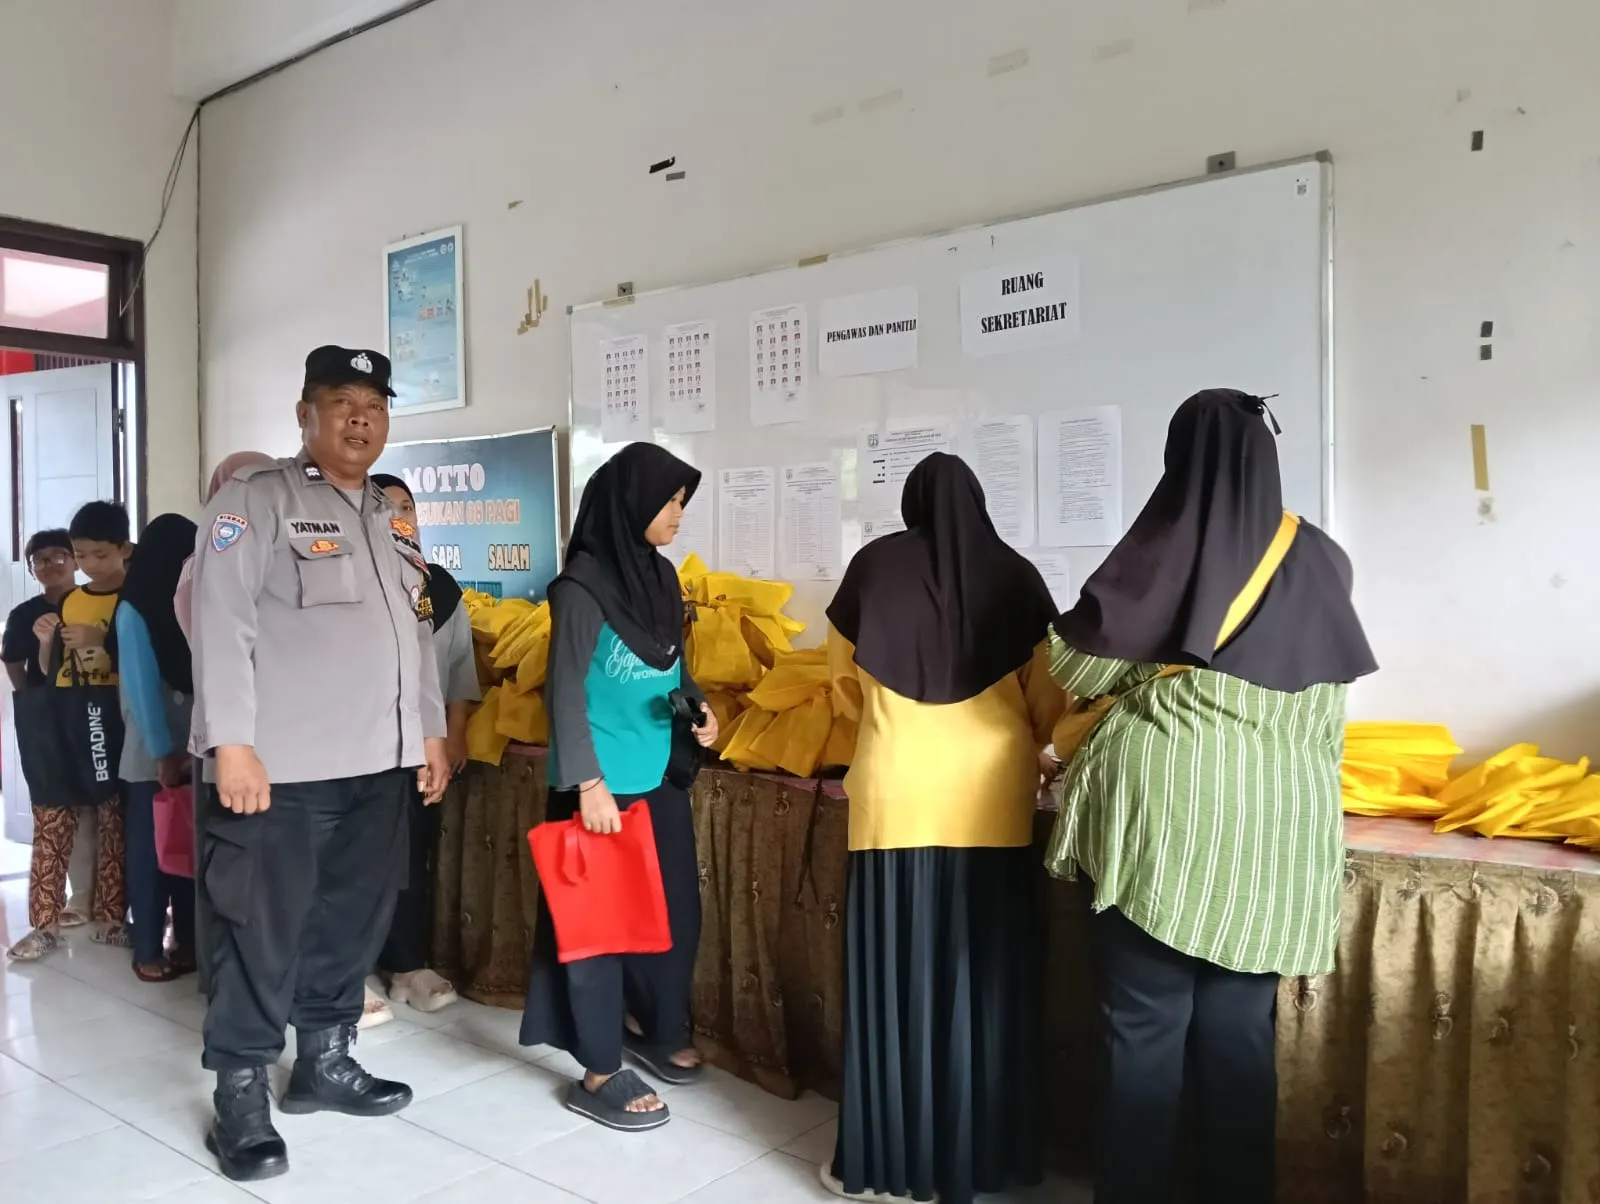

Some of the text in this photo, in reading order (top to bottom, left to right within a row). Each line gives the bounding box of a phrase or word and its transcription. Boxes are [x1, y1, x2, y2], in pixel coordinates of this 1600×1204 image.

[1001, 271, 1044, 296] RUANG
[980, 302, 1067, 334] SEKRETARIAT
[826, 326, 867, 343] PENGAWAS
[868, 324, 884, 337] DAN
[402, 463, 486, 493] MOTTO
[485, 499, 520, 525] PAGI
[290, 521, 341, 534] YATMAN
[431, 544, 531, 572] SAPA SALAM
[88, 706, 109, 782] BETADINE
